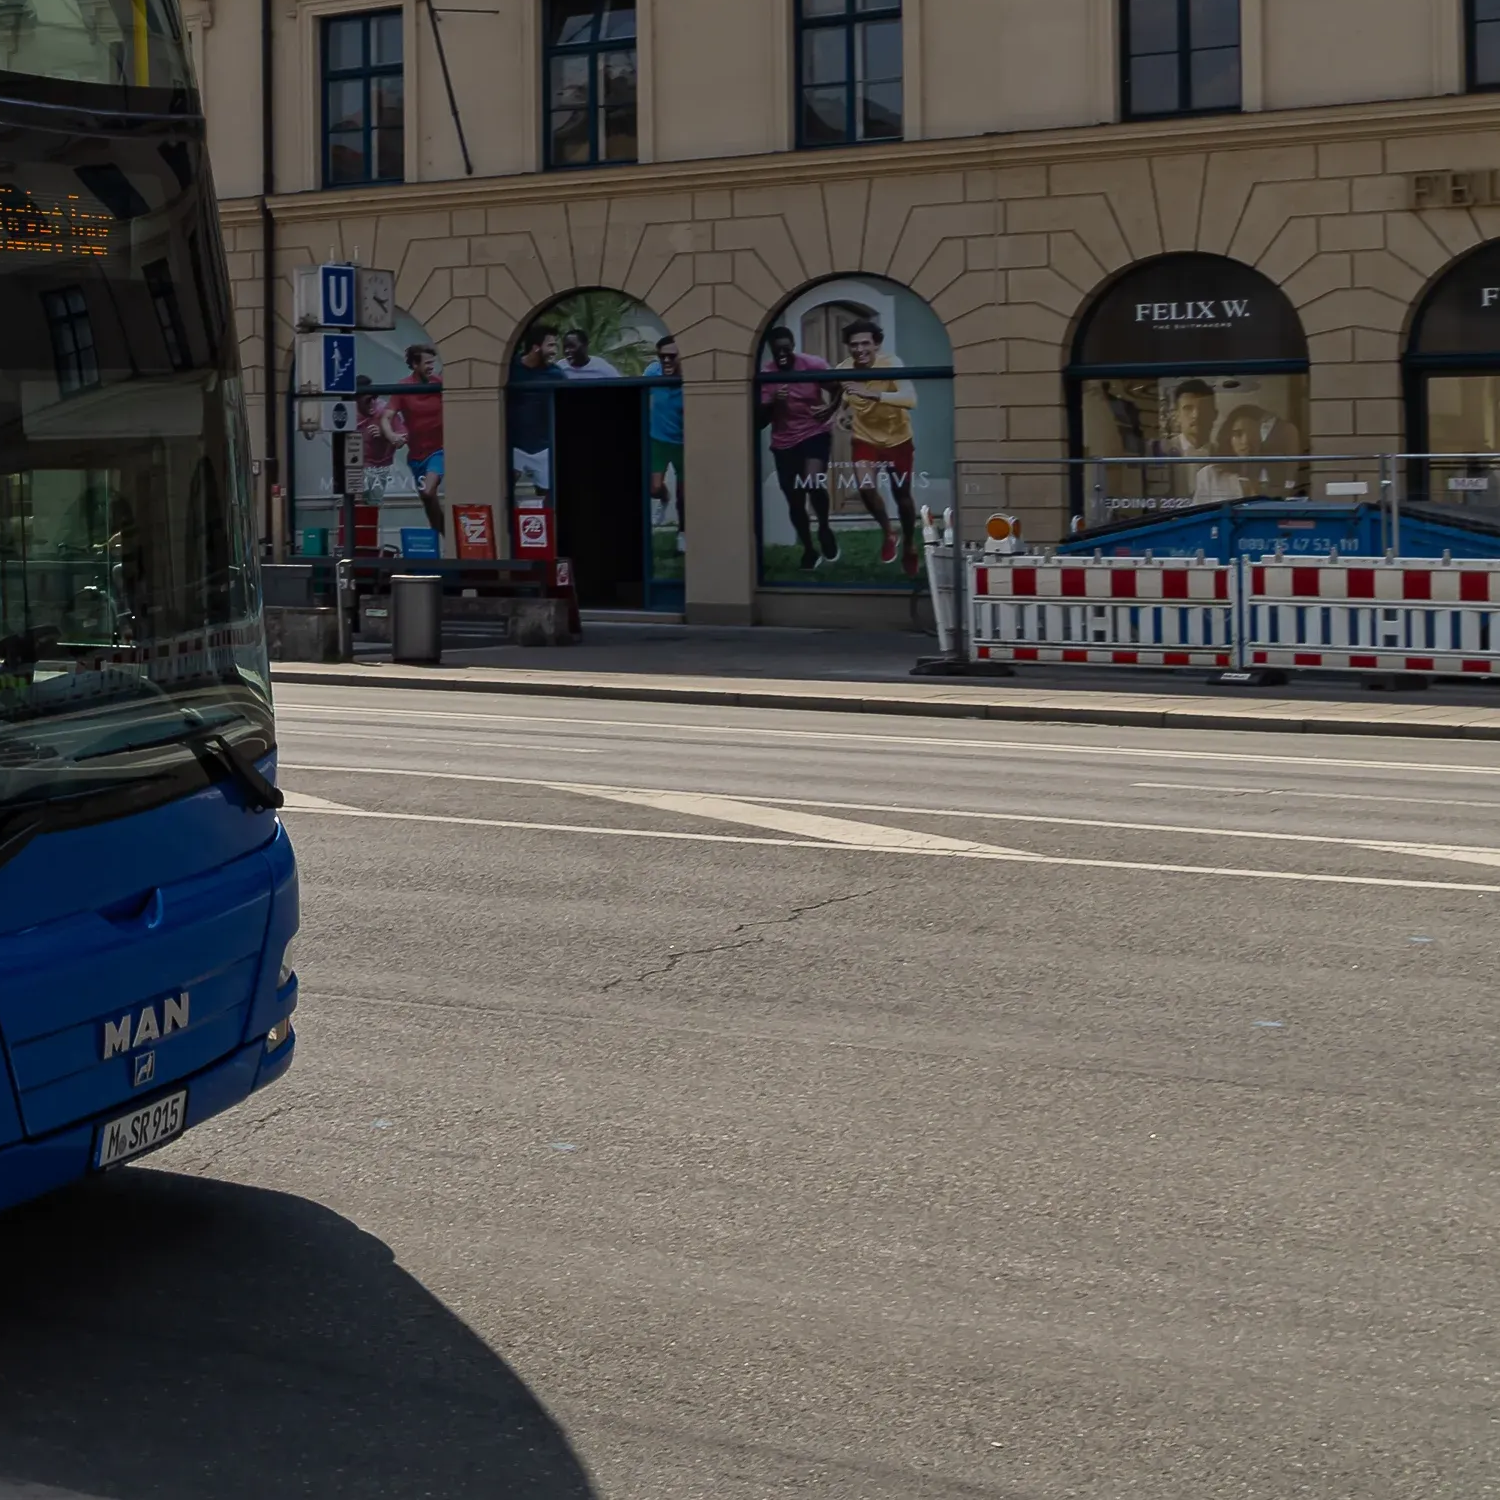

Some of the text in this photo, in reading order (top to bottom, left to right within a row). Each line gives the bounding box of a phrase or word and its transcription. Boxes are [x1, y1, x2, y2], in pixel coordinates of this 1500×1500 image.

[328, 275, 349, 317] U
[1134, 298, 1251, 322] FELIX W.
[793, 470, 932, 490] MR MARVIS
[103, 990, 191, 1061] MAN
[106, 1097, 181, 1160] M SR 915
